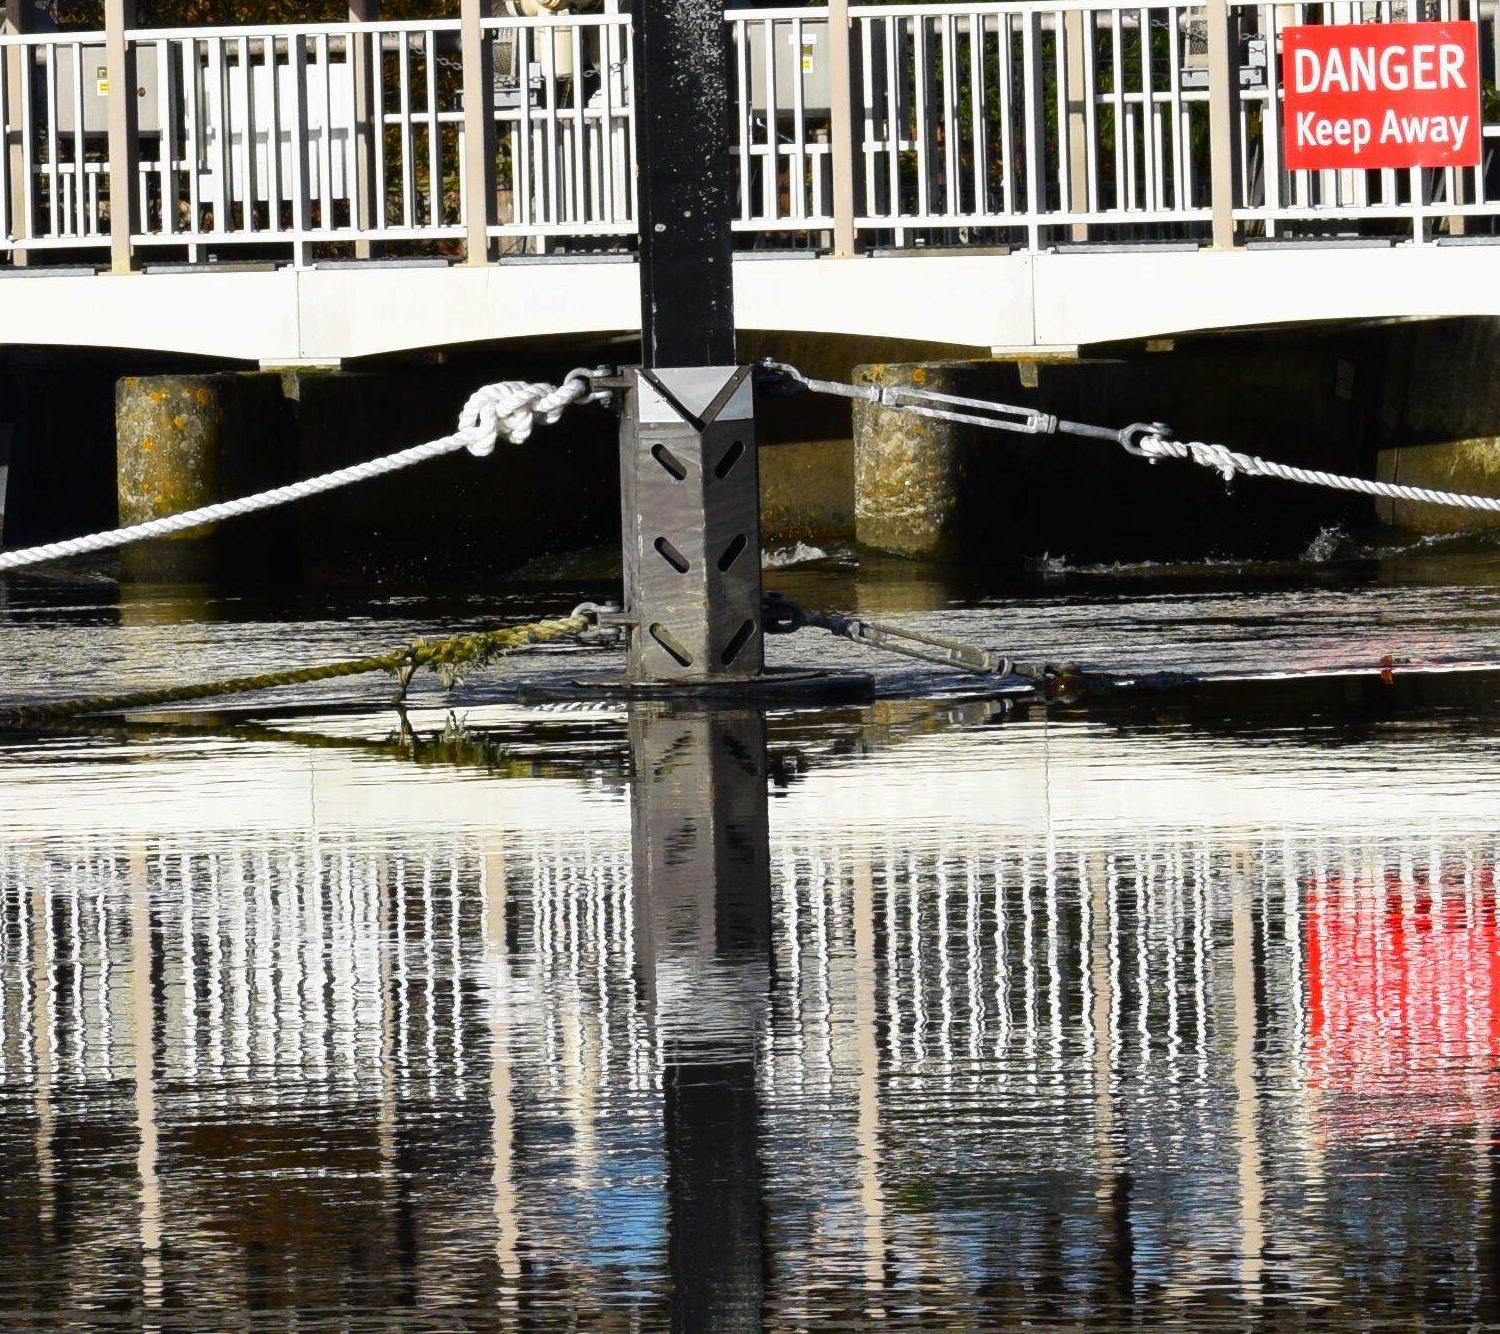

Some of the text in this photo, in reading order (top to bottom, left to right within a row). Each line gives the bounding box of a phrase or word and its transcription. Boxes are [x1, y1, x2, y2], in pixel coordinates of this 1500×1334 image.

[1294, 44, 1467, 94] DANGER
[1296, 109, 1469, 154] Keep Away
